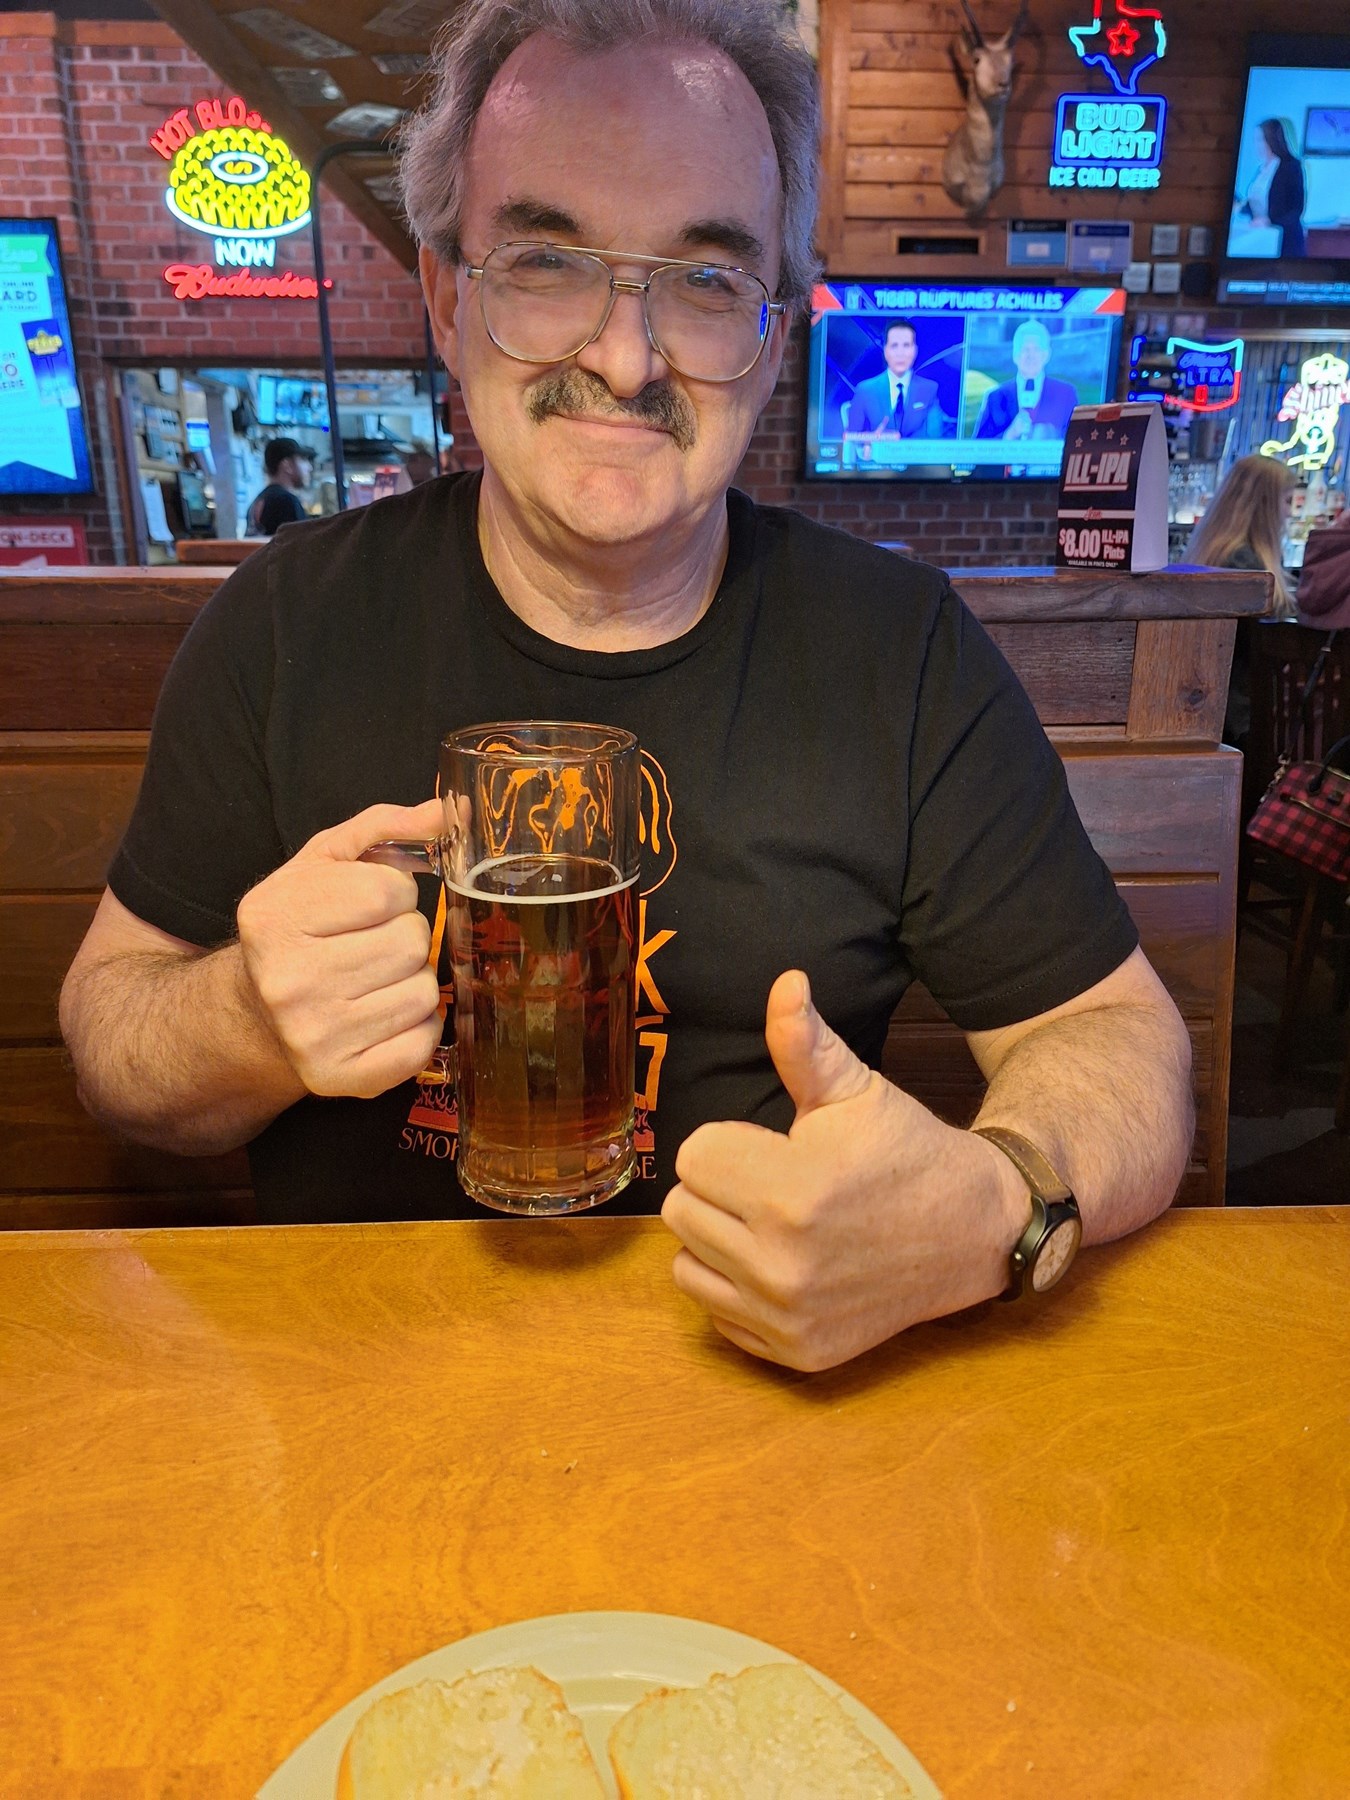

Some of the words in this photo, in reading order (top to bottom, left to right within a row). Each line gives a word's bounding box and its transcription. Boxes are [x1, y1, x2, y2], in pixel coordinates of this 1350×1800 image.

[1076, 102, 1146, 131] BUD
[150, 108, 195, 160] HOT
[1060, 129, 1157, 159] LIGHT
[1049, 166, 1077, 187] ICE
[1077, 167, 1117, 188] COLD
[1118, 168, 1161, 188] BEER
[214, 237, 276, 267] NOW
[874, 289, 917, 308] TIGER
[918, 290, 995, 309] RUPTURES
[996, 291, 1065, 310] ACHILLES
[1065, 450, 1132, 484] ILL-IPA
[1059, 527, 1101, 559] $8.00
[1101, 529, 1130, 544] ILL-IPA
[1103, 545, 1126, 560] Pints
